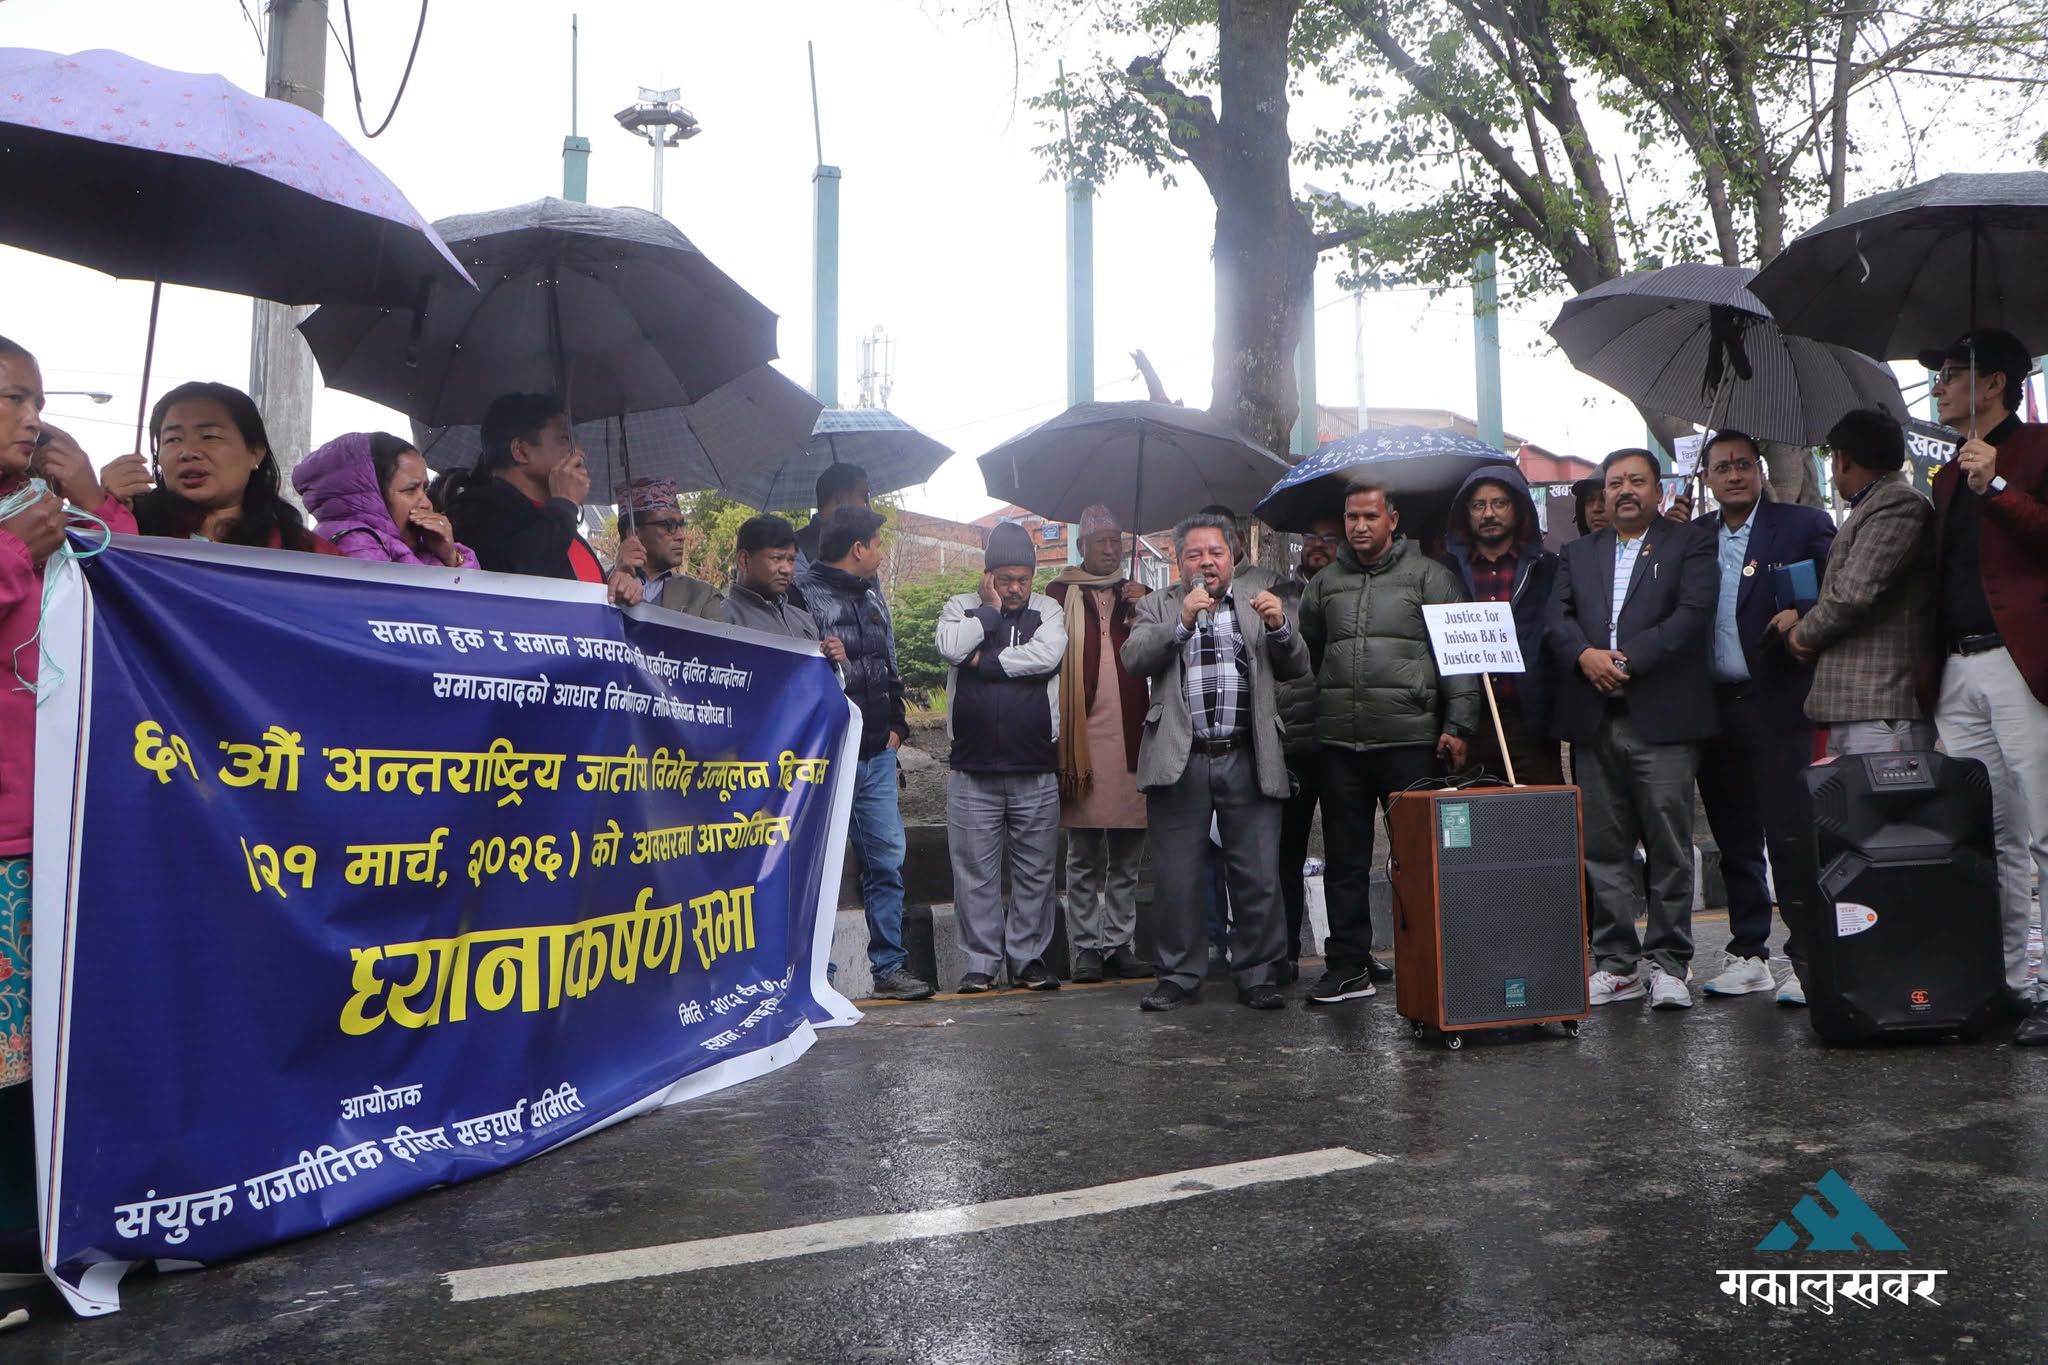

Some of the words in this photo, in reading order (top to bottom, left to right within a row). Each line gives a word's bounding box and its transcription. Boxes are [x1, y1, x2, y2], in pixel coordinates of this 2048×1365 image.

[1444, 610, 1483, 625] Justice
[1484, 609, 1500, 622] for
[367, 620, 442, 645] समान
[444, 626, 485, 653] हक
[488, 630, 508, 651] र
[510, 631, 571, 656] समान
[682, 656, 709, 686] दलित
[708, 662, 748, 690] आन्दोलन
[1444, 630, 1478, 645] Inisha
[1499, 629, 1508, 643] is
[1442, 650, 1481, 666] Justice
[1483, 649, 1498, 664] for
[1501, 650, 1515, 664] All
[433, 672, 551, 709] समाजवादको
[552, 681, 602, 710] आधार
[134, 720, 200, 784] ६१
[576, 744, 648, 793] जातीय
[697, 761, 770, 802] उन्मूलन
[344, 827, 450, 889] मार्च,
[591, 819, 624, 868] को
[629, 825, 694, 866] अवसरमा
[697, 811, 791, 853] आयोजित
[689, 885, 756, 971] सभा
[678, 1000, 705, 1027] मिति
[340, 1084, 423, 1120] आयोजक
[113, 1189, 237, 1245] संयुक्त
[244, 1144, 384, 1212] राजनीतिक
[381, 1125, 454, 1163] दलित
[530, 1081, 586, 1128] समिति
